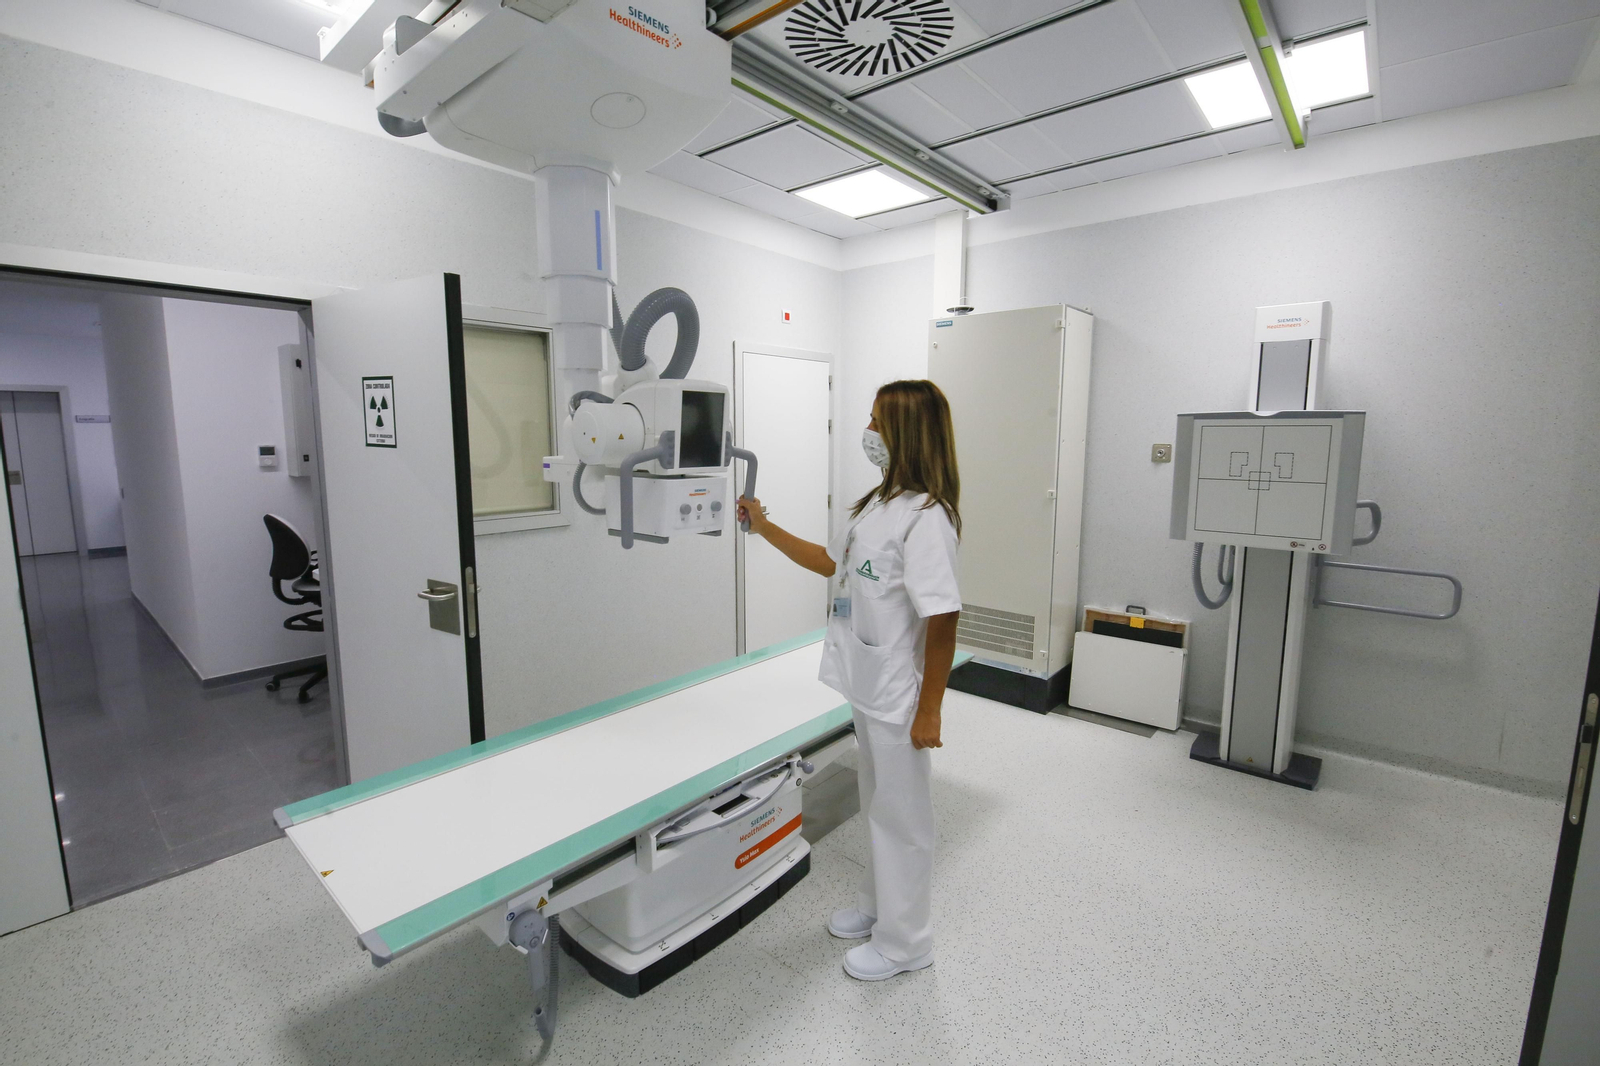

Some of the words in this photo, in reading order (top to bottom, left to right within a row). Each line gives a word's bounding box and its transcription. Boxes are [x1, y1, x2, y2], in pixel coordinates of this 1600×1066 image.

[609, 8, 669, 48] Healthineers
[628, 6, 669, 34] SIEMENS
[739, 816, 776, 843] Healthineers
[750, 807, 776, 828] SIEMENS
